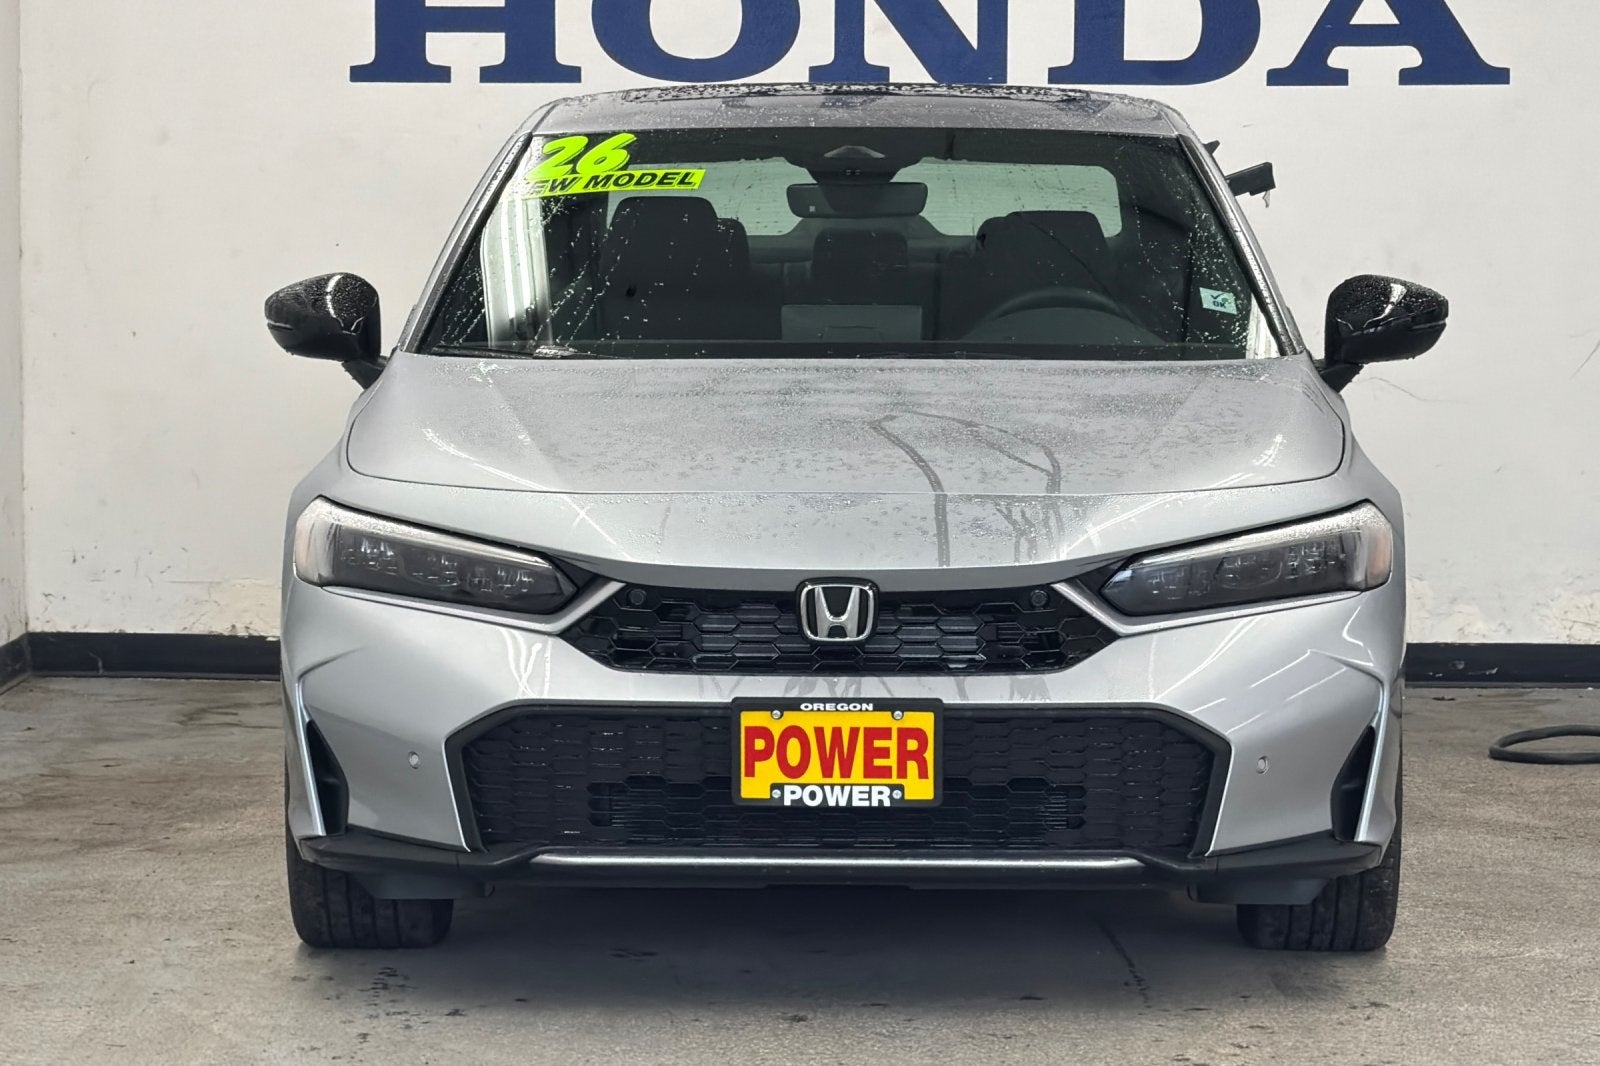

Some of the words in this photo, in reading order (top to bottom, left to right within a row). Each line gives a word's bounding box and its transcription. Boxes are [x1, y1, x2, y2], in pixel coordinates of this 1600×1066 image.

[349, 0, 1511, 87] HONDA
[526, 132, 638, 181] 26
[582, 170, 697, 190] MODEL
[799, 702, 874, 712] OREGON
[743, 724, 930, 780] POWER
[783, 784, 891, 807] POWER
